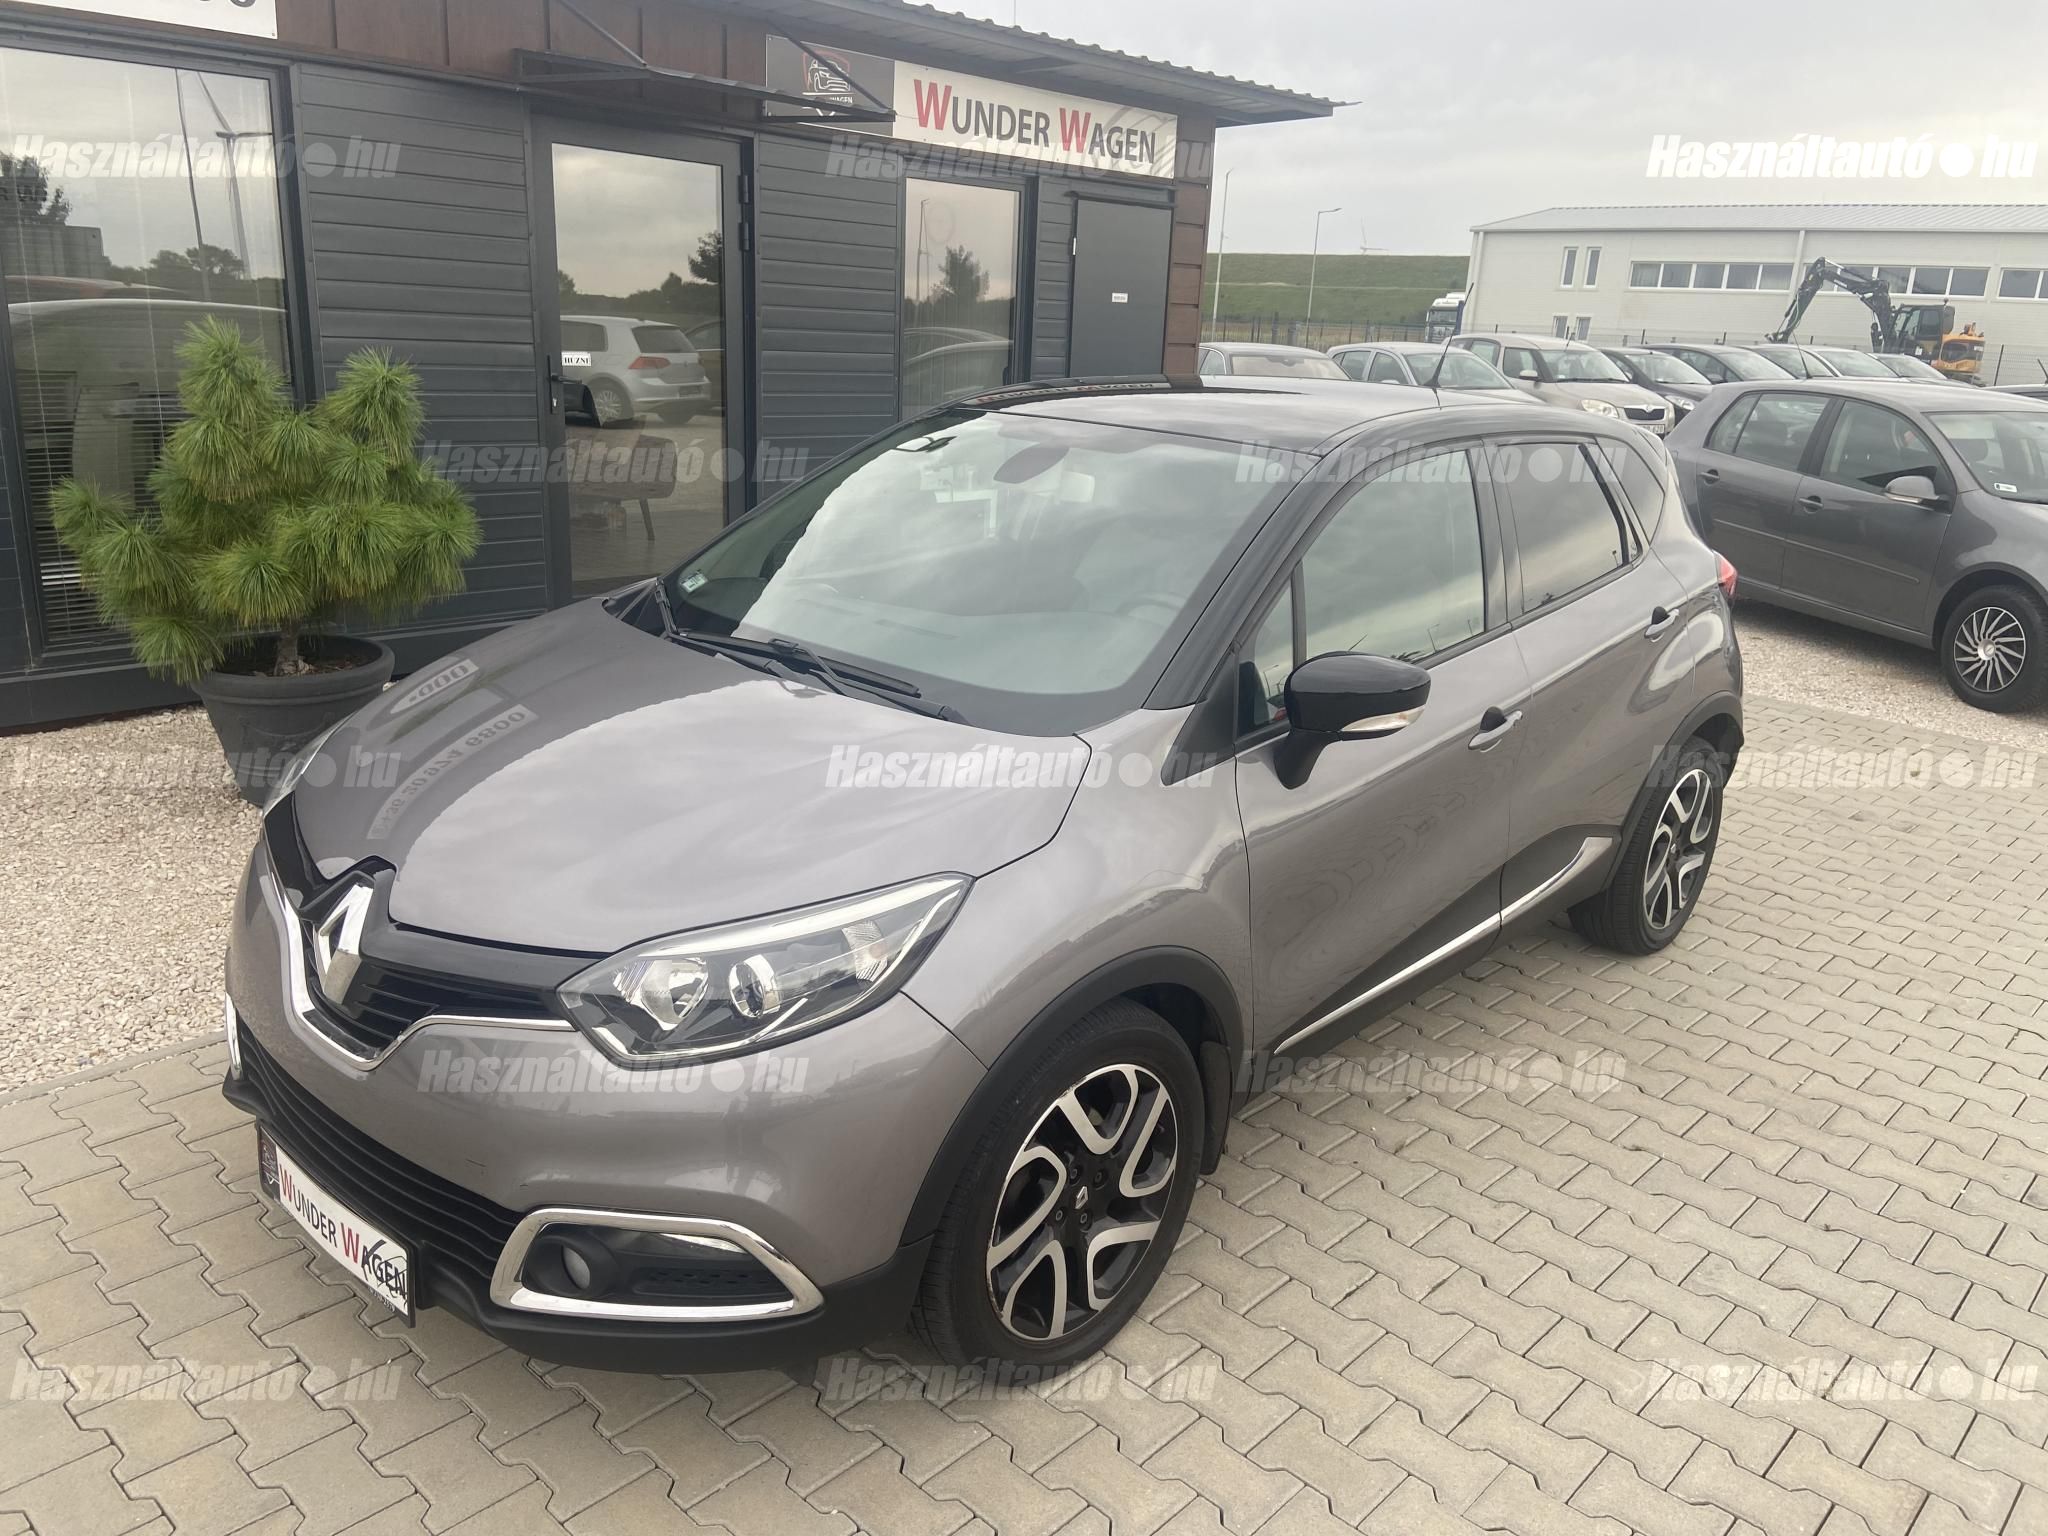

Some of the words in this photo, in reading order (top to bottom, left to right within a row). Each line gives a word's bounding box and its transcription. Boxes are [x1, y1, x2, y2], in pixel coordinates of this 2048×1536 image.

[914, 79, 1050, 147] WUNDER
[1059, 107, 1155, 163] WAGEN
[279, 1163, 338, 1249] WUNDER
